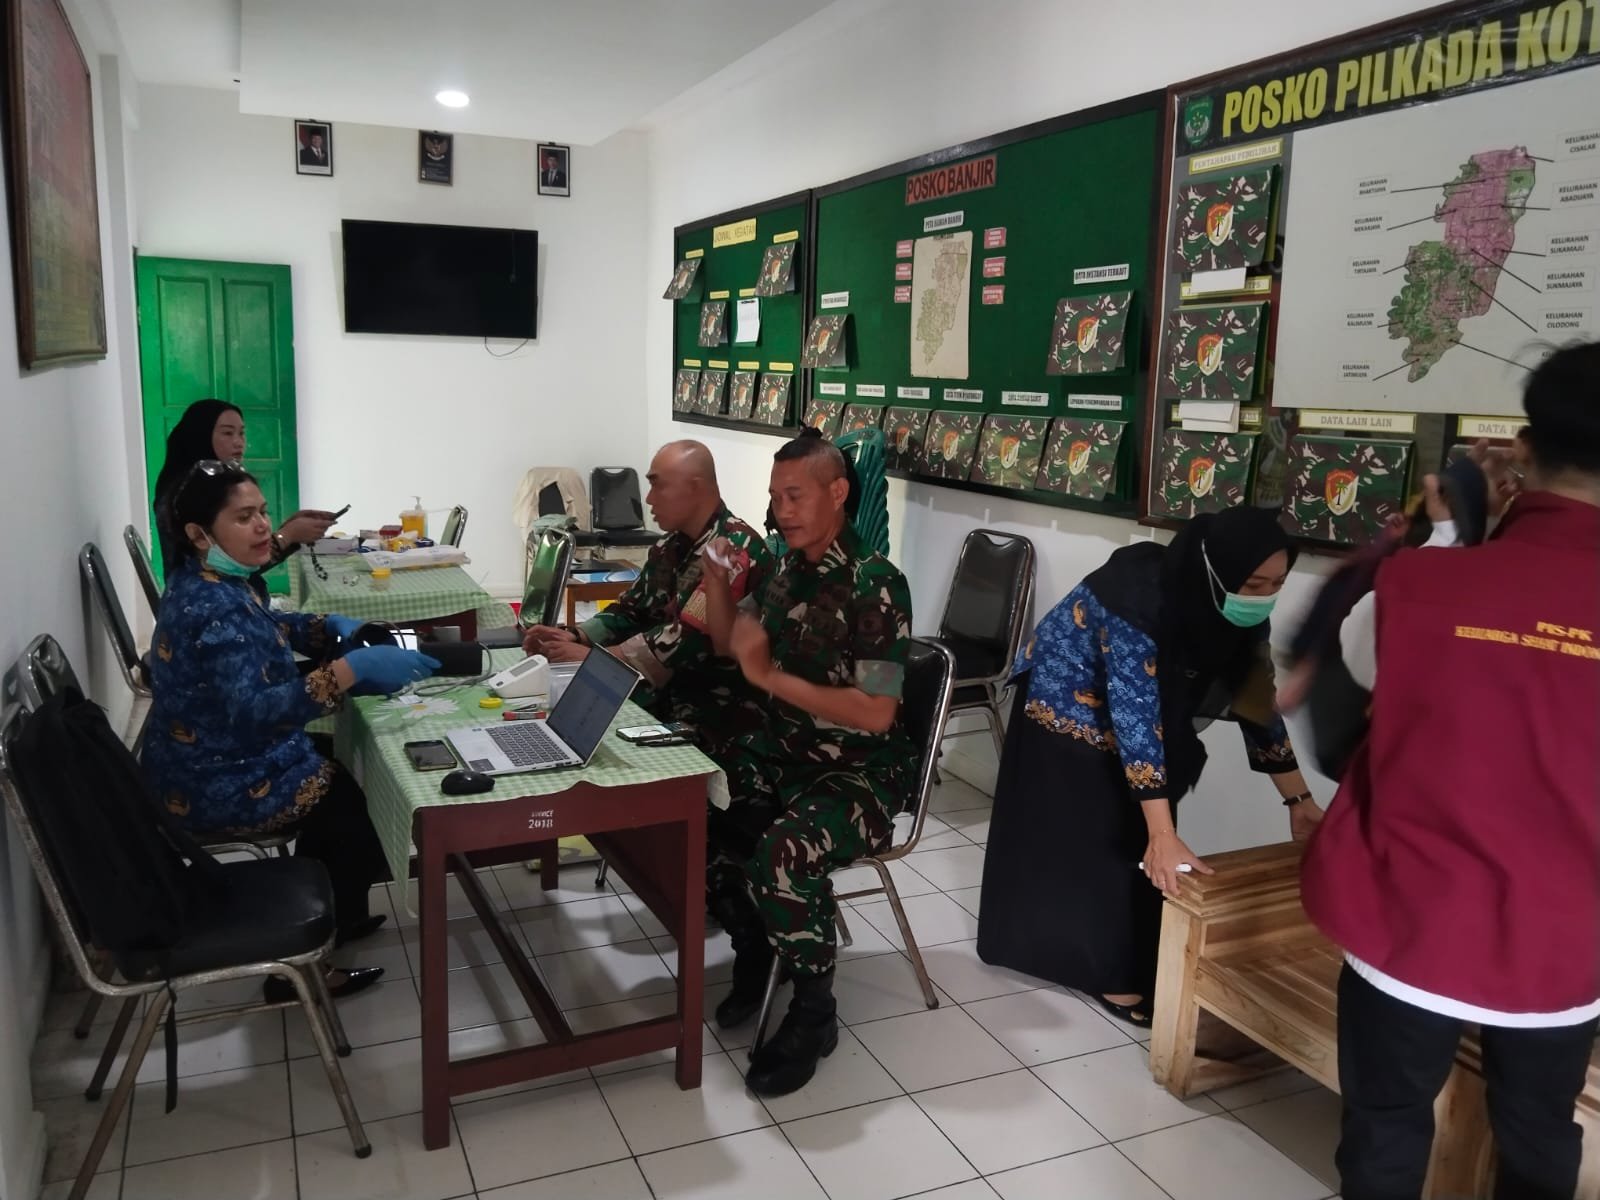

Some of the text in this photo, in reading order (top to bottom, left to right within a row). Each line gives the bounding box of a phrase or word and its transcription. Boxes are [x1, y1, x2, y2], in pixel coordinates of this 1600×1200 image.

[1222, 67, 1327, 138] POSKO
[1335, 21, 1503, 112] PILKADA
[1565, 132, 1600, 144] KELURAHA
[906, 159, 994, 202] POSKO BANJIR
[1559, 183, 1598, 193] KELURAHAN
[1551, 235, 1589, 244] KELURAHAN
[1547, 271, 1585, 280] KELURAHAN
[1545, 312, 1583, 320] KELURAHAN
[1321, 416, 1392, 427] DATA LAIN LAIN
[1478, 423, 1507, 433] DATA
[528, 819, 553, 829] 2018
